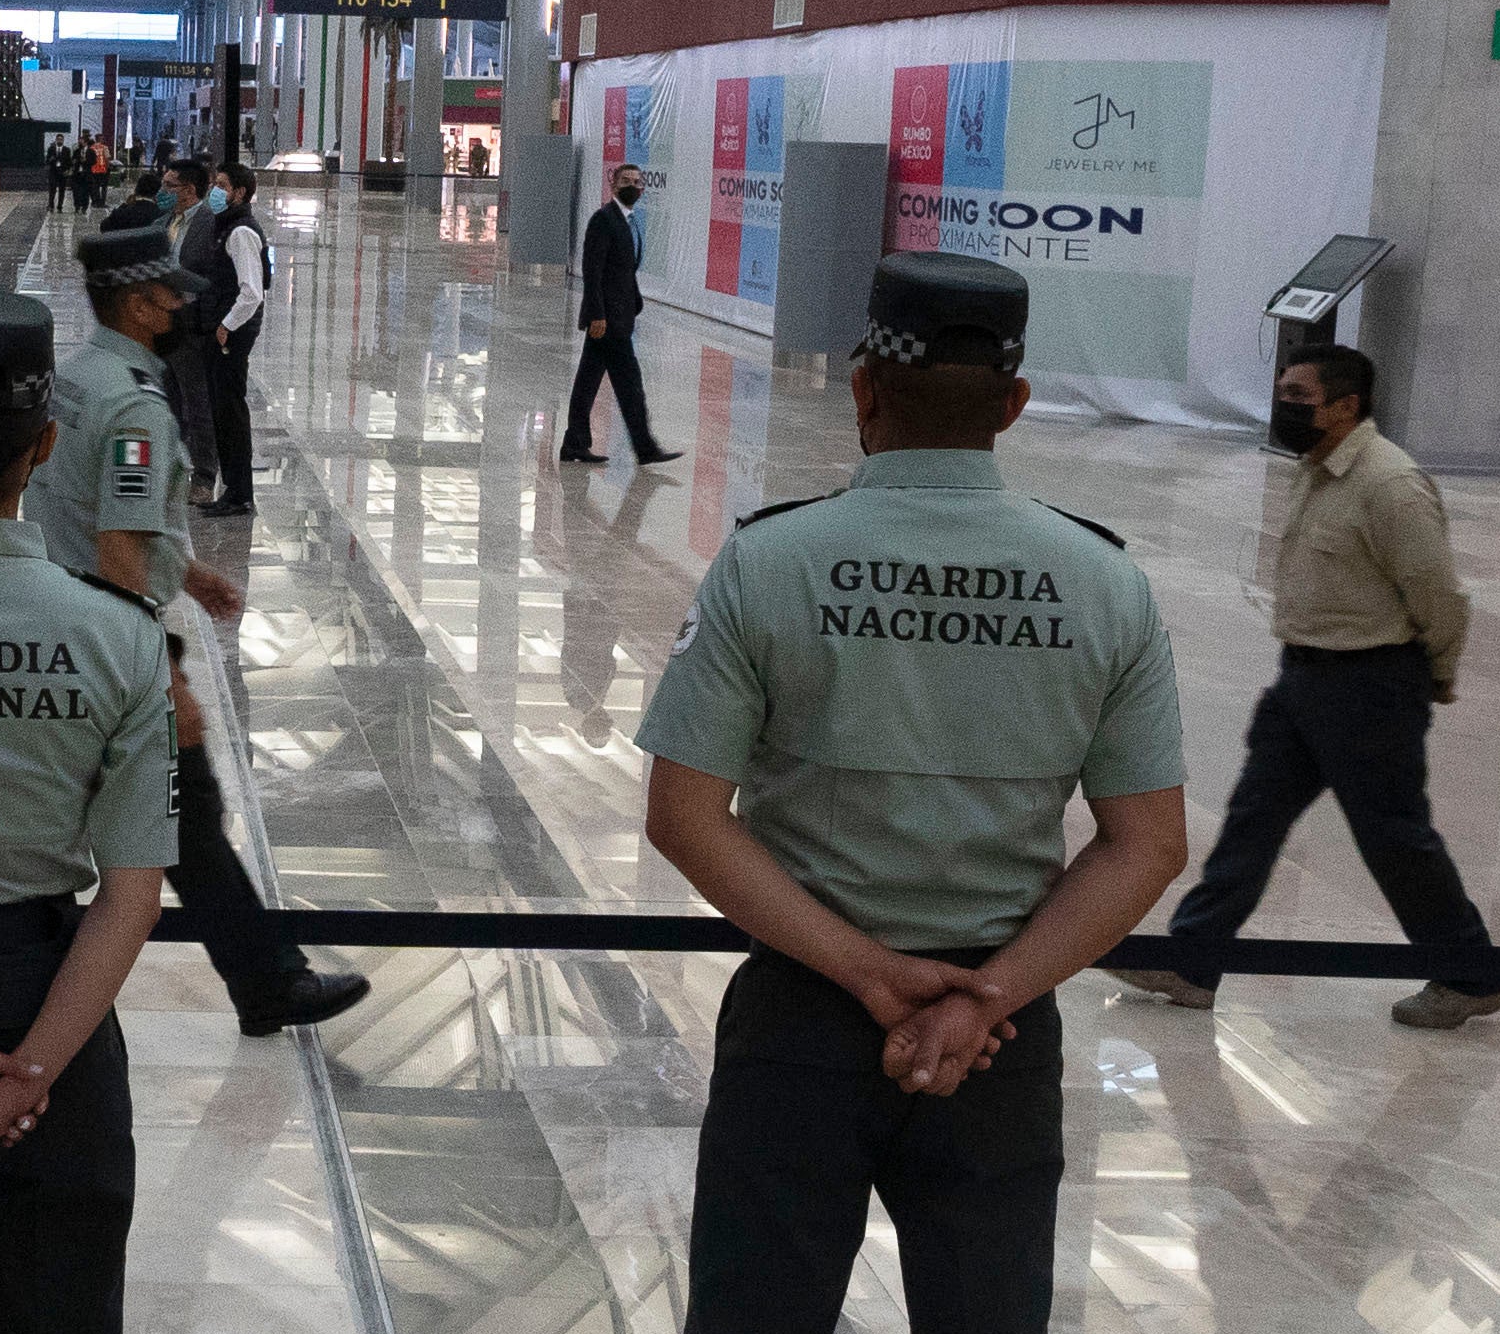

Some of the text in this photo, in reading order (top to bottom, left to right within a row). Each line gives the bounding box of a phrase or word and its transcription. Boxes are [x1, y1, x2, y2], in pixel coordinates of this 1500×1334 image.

[1044, 158, 1159, 173] JEWELRY ME
[719, 177, 768, 200] COMING
[899, 194, 1144, 235] COMING SOON
[830, 559, 1063, 604] GUARDIA
[819, 604, 1074, 649] NACIONAL
